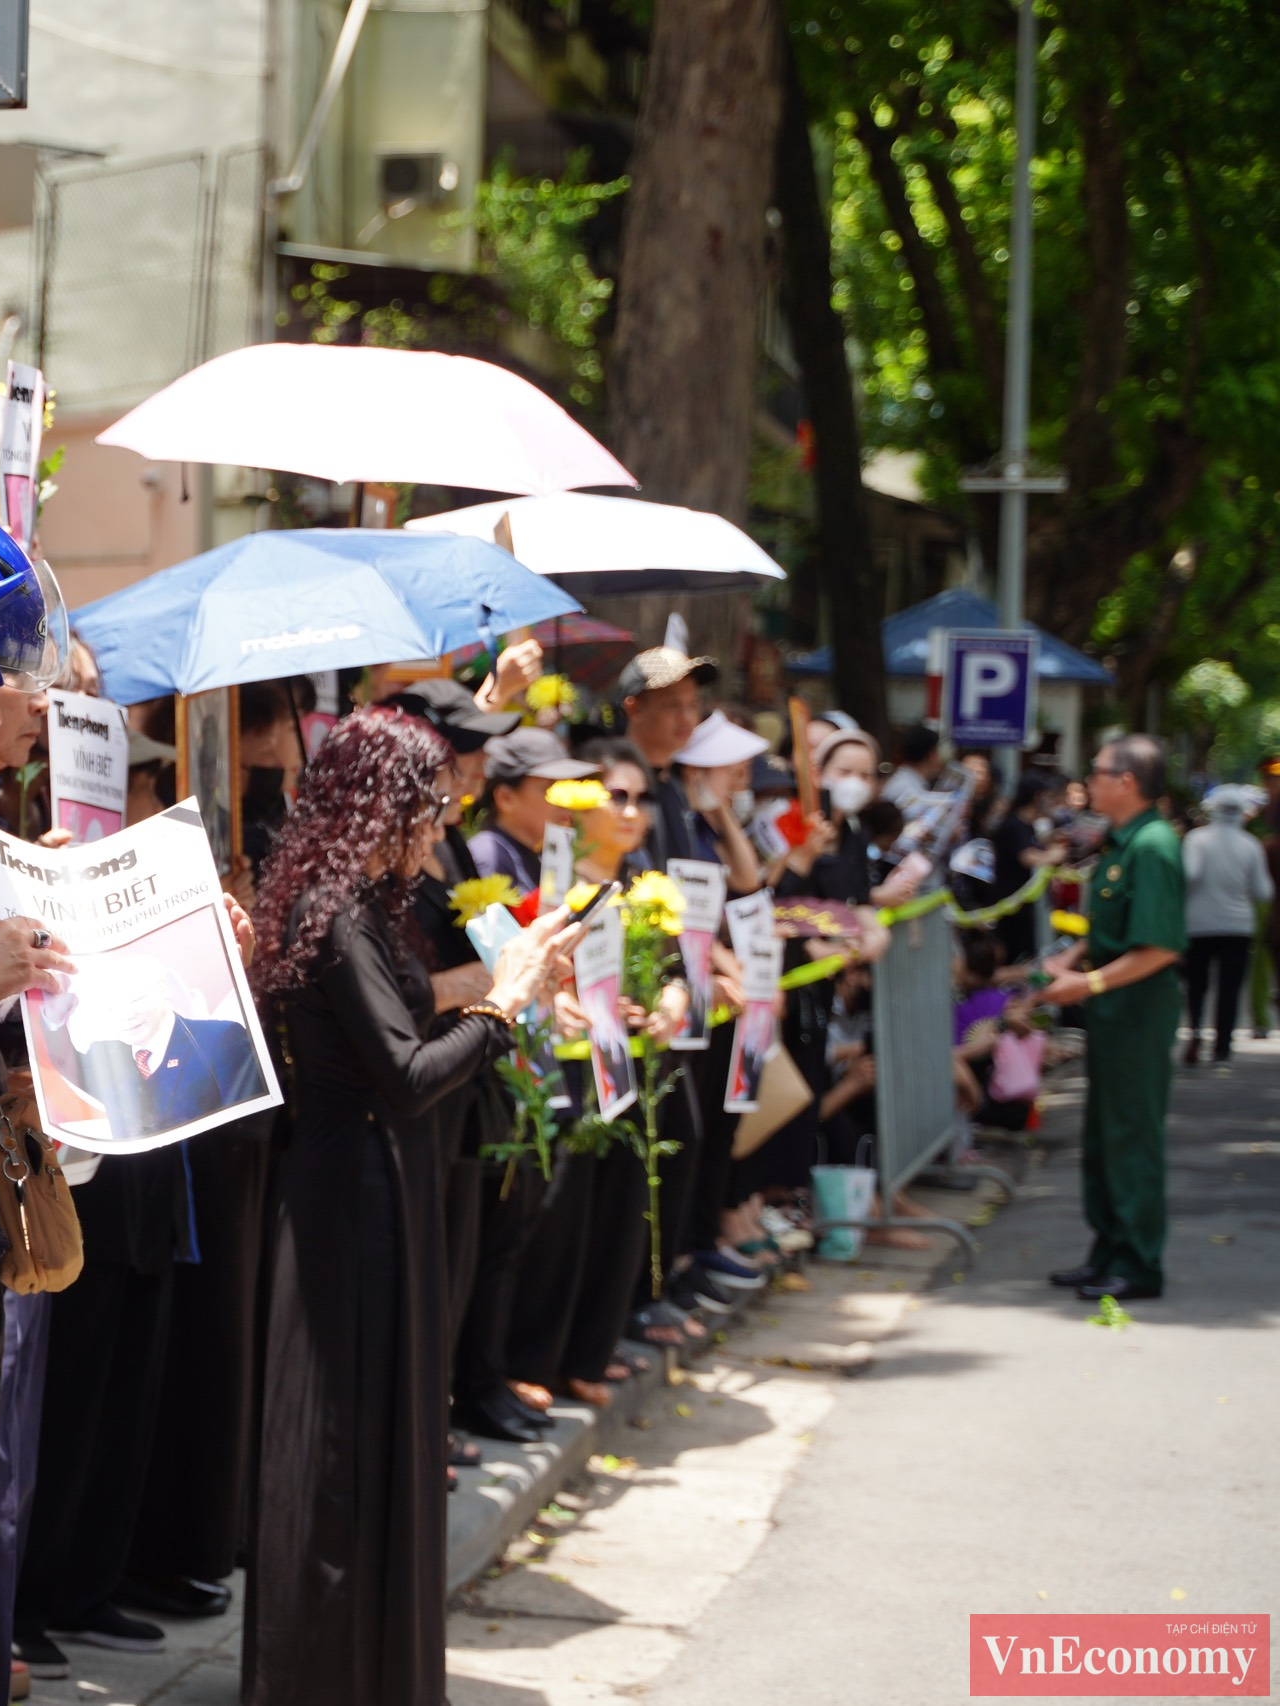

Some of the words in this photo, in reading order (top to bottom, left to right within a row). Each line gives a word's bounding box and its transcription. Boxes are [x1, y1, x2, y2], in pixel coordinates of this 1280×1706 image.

[240, 624, 362, 655] mobifone
[960, 653, 1019, 720] P
[104, 873, 157, 915] BIỆT
